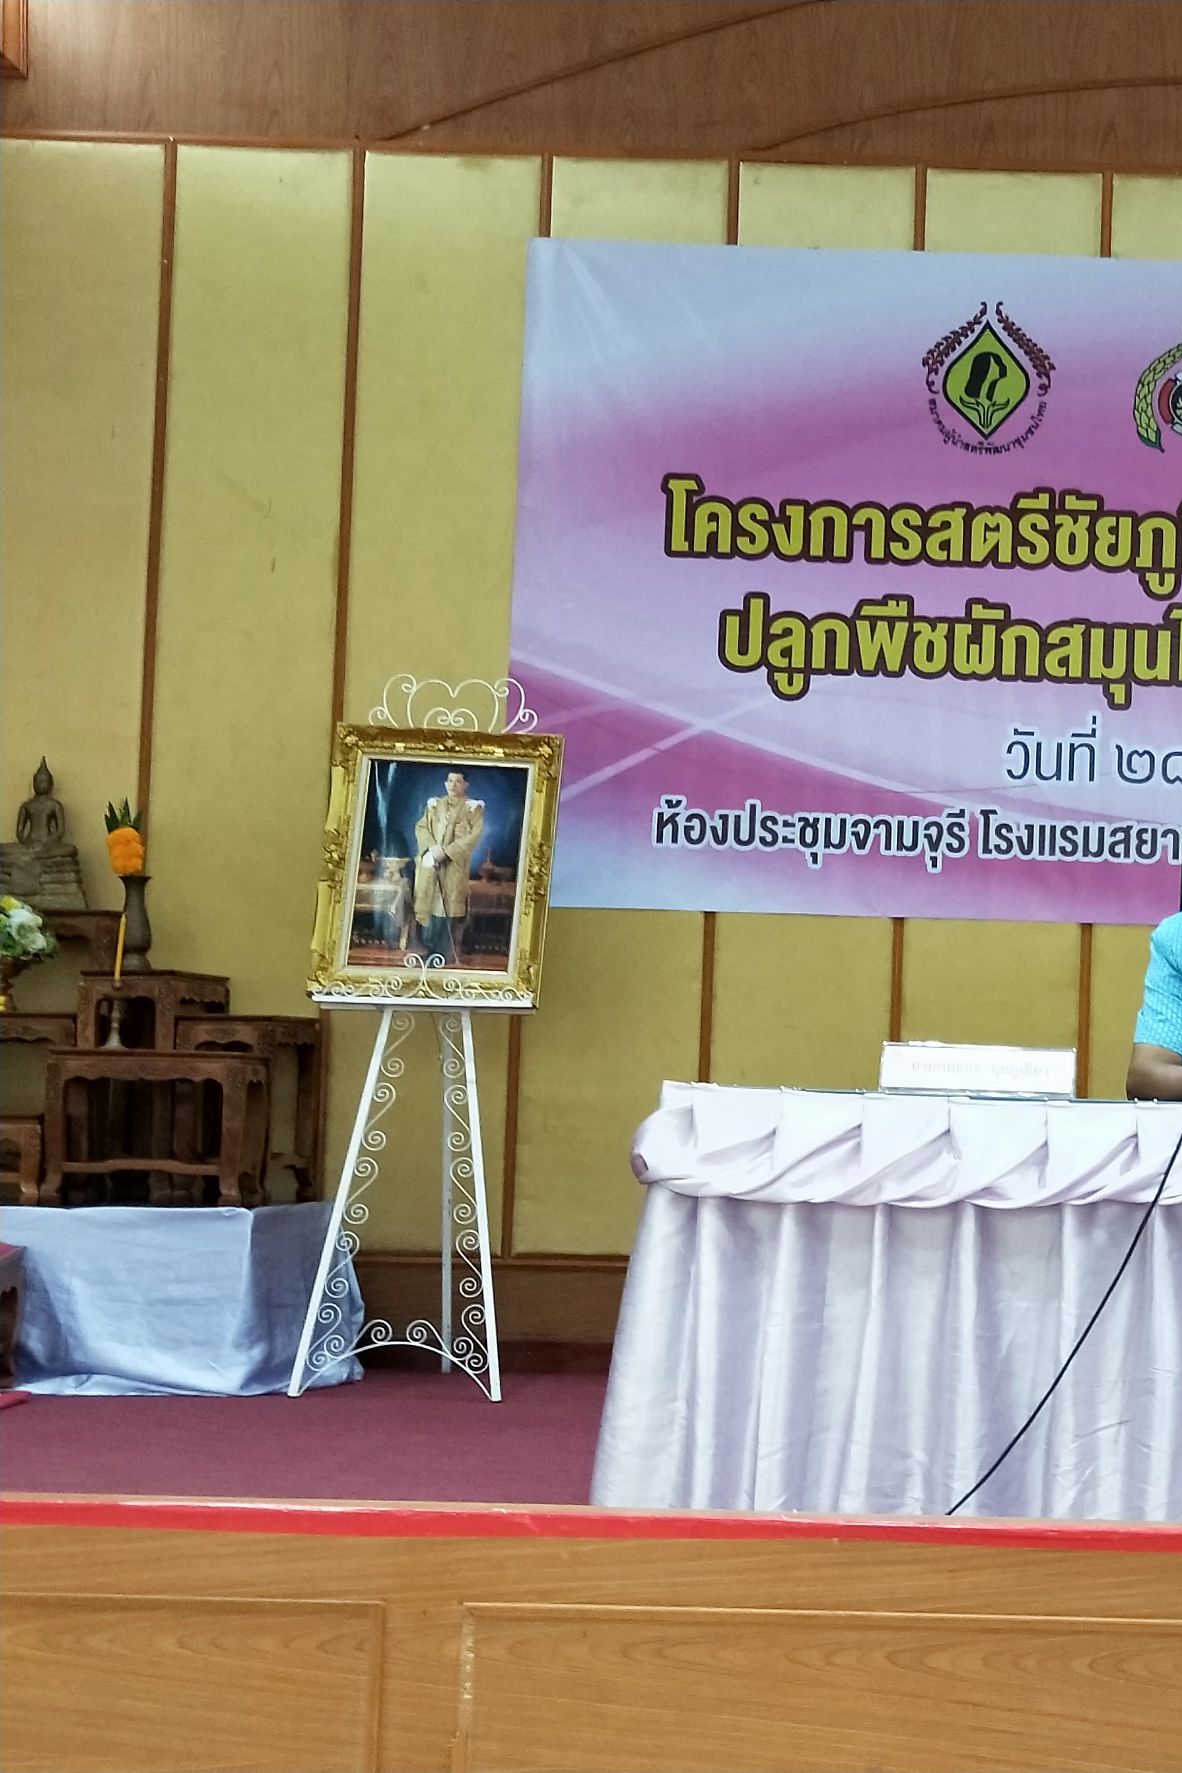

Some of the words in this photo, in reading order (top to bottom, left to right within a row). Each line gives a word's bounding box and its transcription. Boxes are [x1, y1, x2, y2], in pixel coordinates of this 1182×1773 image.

[1005, 715, 1097, 784] วันที่
[654, 797, 967, 870] ห้องประชุมจามจุรี
